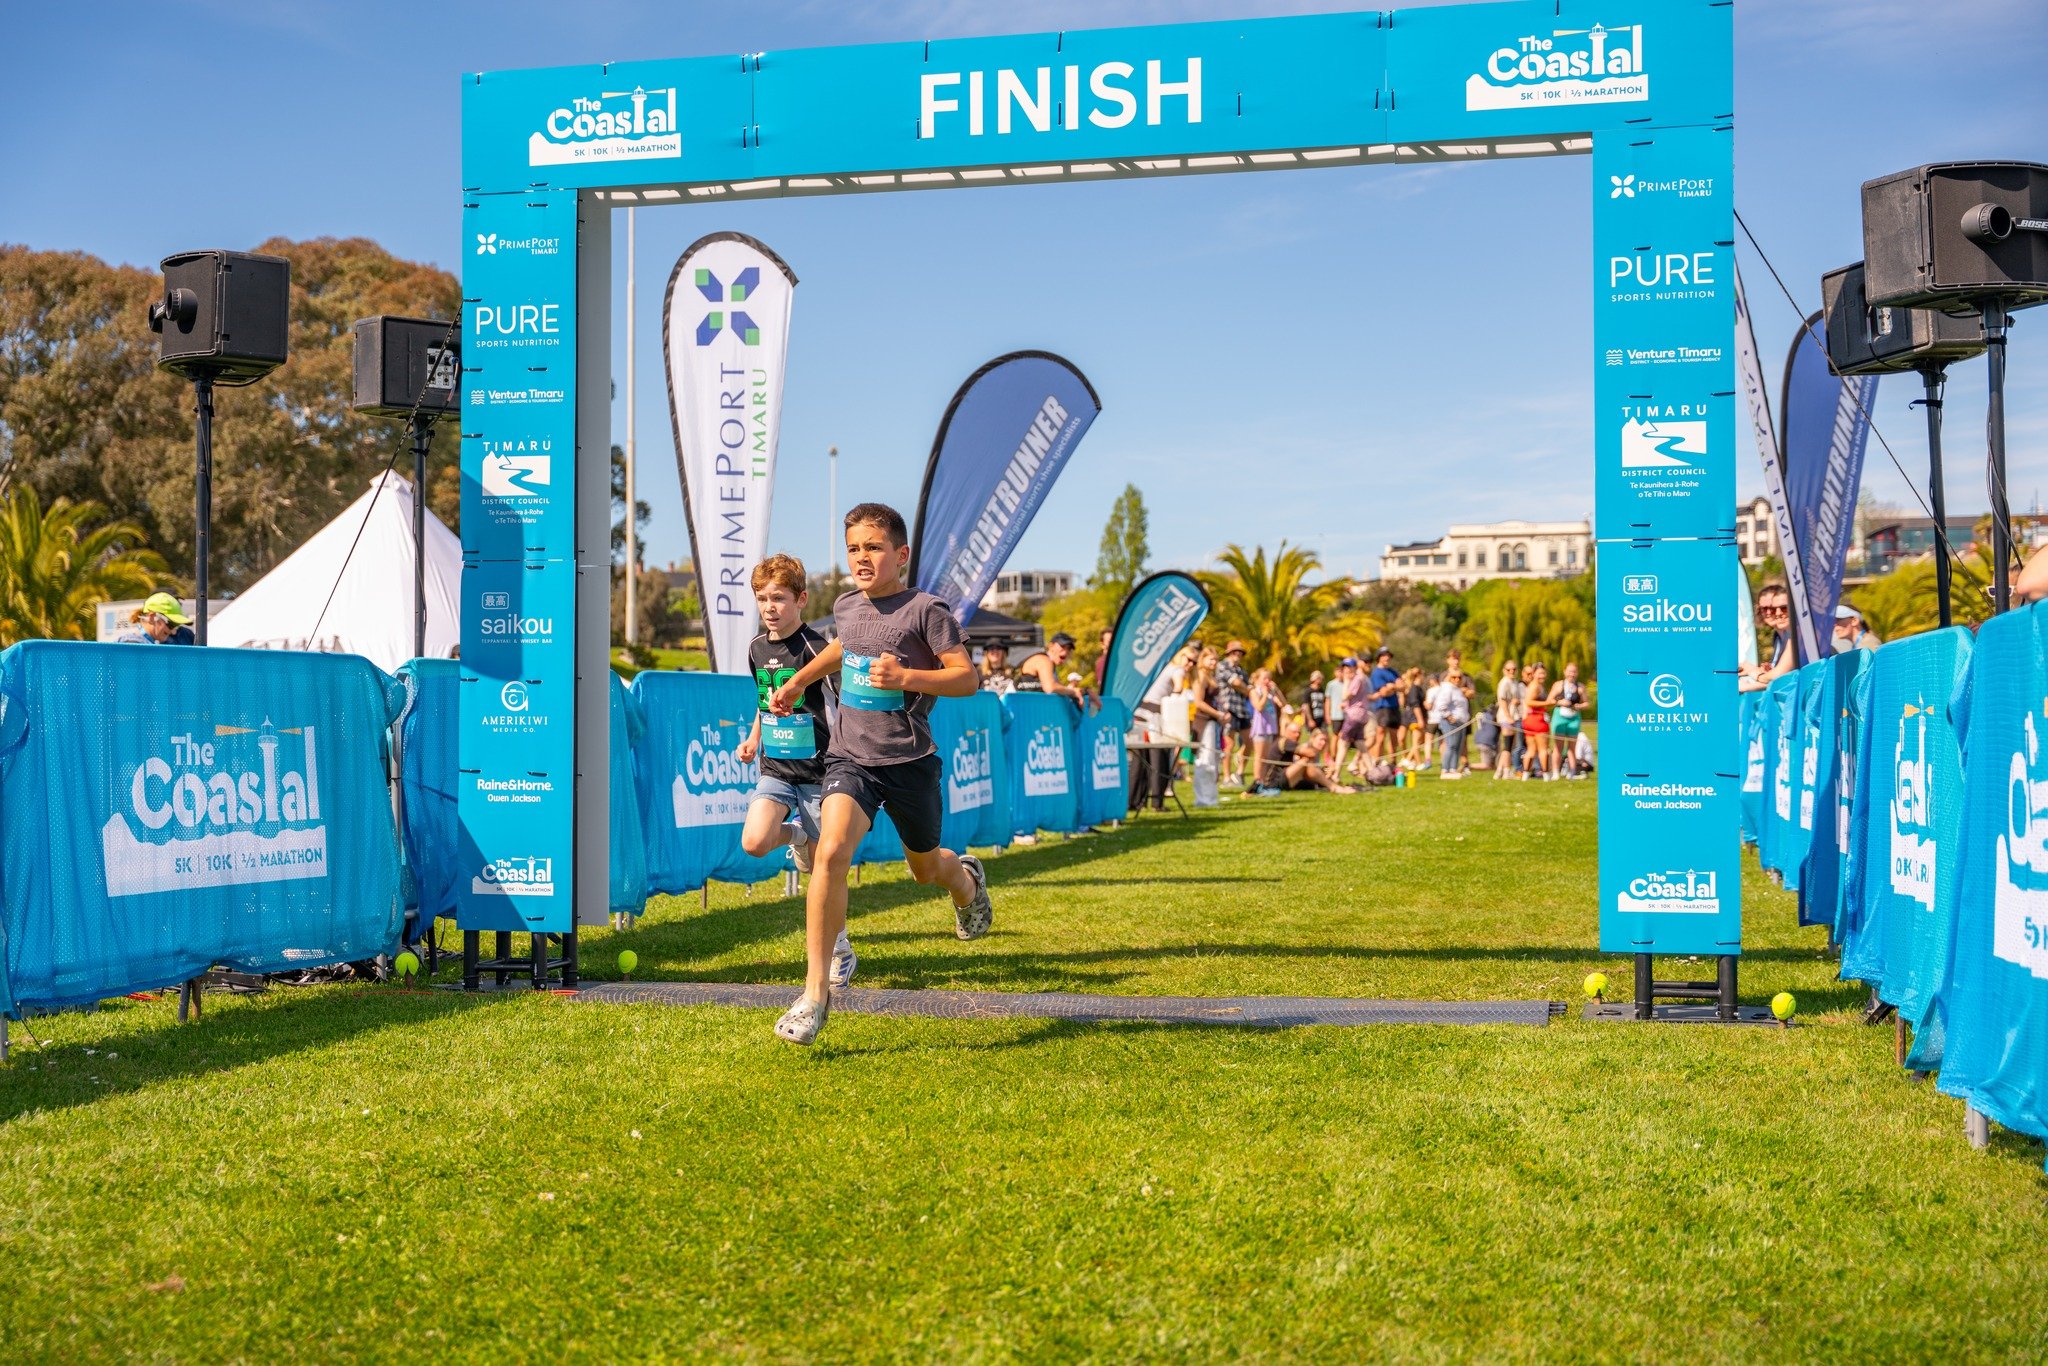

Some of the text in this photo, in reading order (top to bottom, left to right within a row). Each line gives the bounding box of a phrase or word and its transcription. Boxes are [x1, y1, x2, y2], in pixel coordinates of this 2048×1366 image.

[1518, 35, 1553, 52] The
[1488, 23, 1643, 81] Coastal
[921, 57, 1202, 139] FINISH
[1521, 91, 1533, 100] 5K
[1543, 90, 1561, 99] 10K
[1584, 86, 1642, 97] MARATHON
[573, 97, 601, 112] The
[547, 86, 676, 139] Coastal
[574, 149, 585, 157] 5K
[593, 147, 608, 156] 10K
[627, 143, 676, 153] MARATHON
[2021, 219, 2048, 229] BOSE
[1611, 252, 1714, 288] PURE
[1611, 290, 1715, 302] SPORTS NUTRITION
[476, 304, 559, 335] PURE
[476, 340, 508, 348] SPORTS
[1627, 347, 1721, 359] Venture Timaru
[488, 389, 564, 399] Venture Timaru
[1622, 404, 1707, 417] TIMARU
[752, 368, 767, 481] TIMARU
[483, 441, 551, 451] TIMARU
[1622, 468, 1707, 477] DISTRICT COUNCIL
[1814, 375, 1863, 573] FRONTRUNNE
[1006, 508, 1028, 545] original
[1025, 479, 1043, 511] sports
[1040, 458, 1056, 482] shoe
[1052, 416, 1082, 460] specialists
[1639, 481, 1674, 489] Kaunihera
[950, 395, 1069, 597] FRONTRUNNER
[1627, 578, 1654, 592] 最高
[1623, 599, 1712, 622] saikou
[481, 614, 552, 635] saikou
[1132, 584, 1188, 657] Coastal
[852, 673, 872, 687] 505
[482, 716, 548, 725] AMERIKIWI
[1626, 713, 1708, 724] AMERIKIWI
[701, 723, 720, 746] The
[772, 729, 794, 740] 5012
[171, 732, 214, 766] The
[686, 720, 760, 786] Coasta
[132, 722, 320, 830] Coastal
[1621, 783, 1717, 796] Raine&Horne.
[487, 794, 541, 802] Owen Jackson
[1634, 800, 1701, 809] Owen Jackson
[705, 804, 713, 815] 5K
[718, 803, 729, 815] 10K
[175, 857, 192, 874] 5K
[206, 853, 232, 872] 10K
[259, 848, 323, 867] MARATHON
[496, 859, 511, 867] The
[482, 857, 552, 882] Coastal
[1629, 870, 1716, 898] Coastal
[1647, 873, 1666, 882] The
